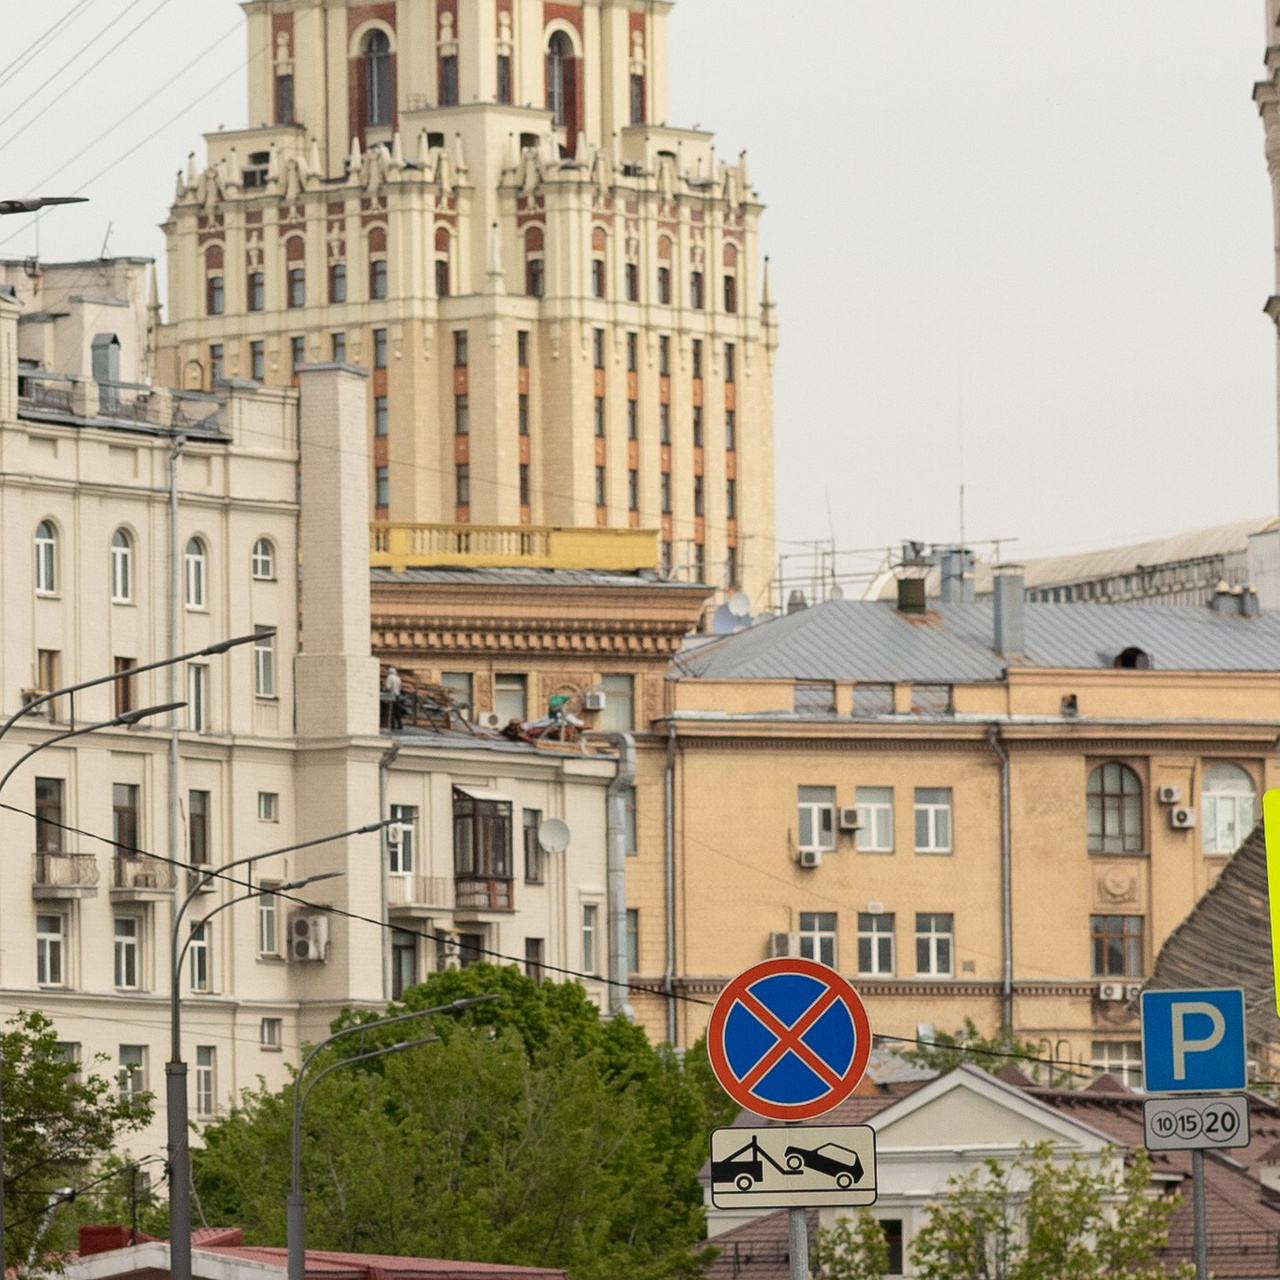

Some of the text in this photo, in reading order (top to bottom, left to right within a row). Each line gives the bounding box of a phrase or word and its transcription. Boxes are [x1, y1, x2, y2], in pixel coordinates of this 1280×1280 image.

[1170, 1001, 1226, 1081] P
[1156, 1110, 1236, 1133] 10 15 20
